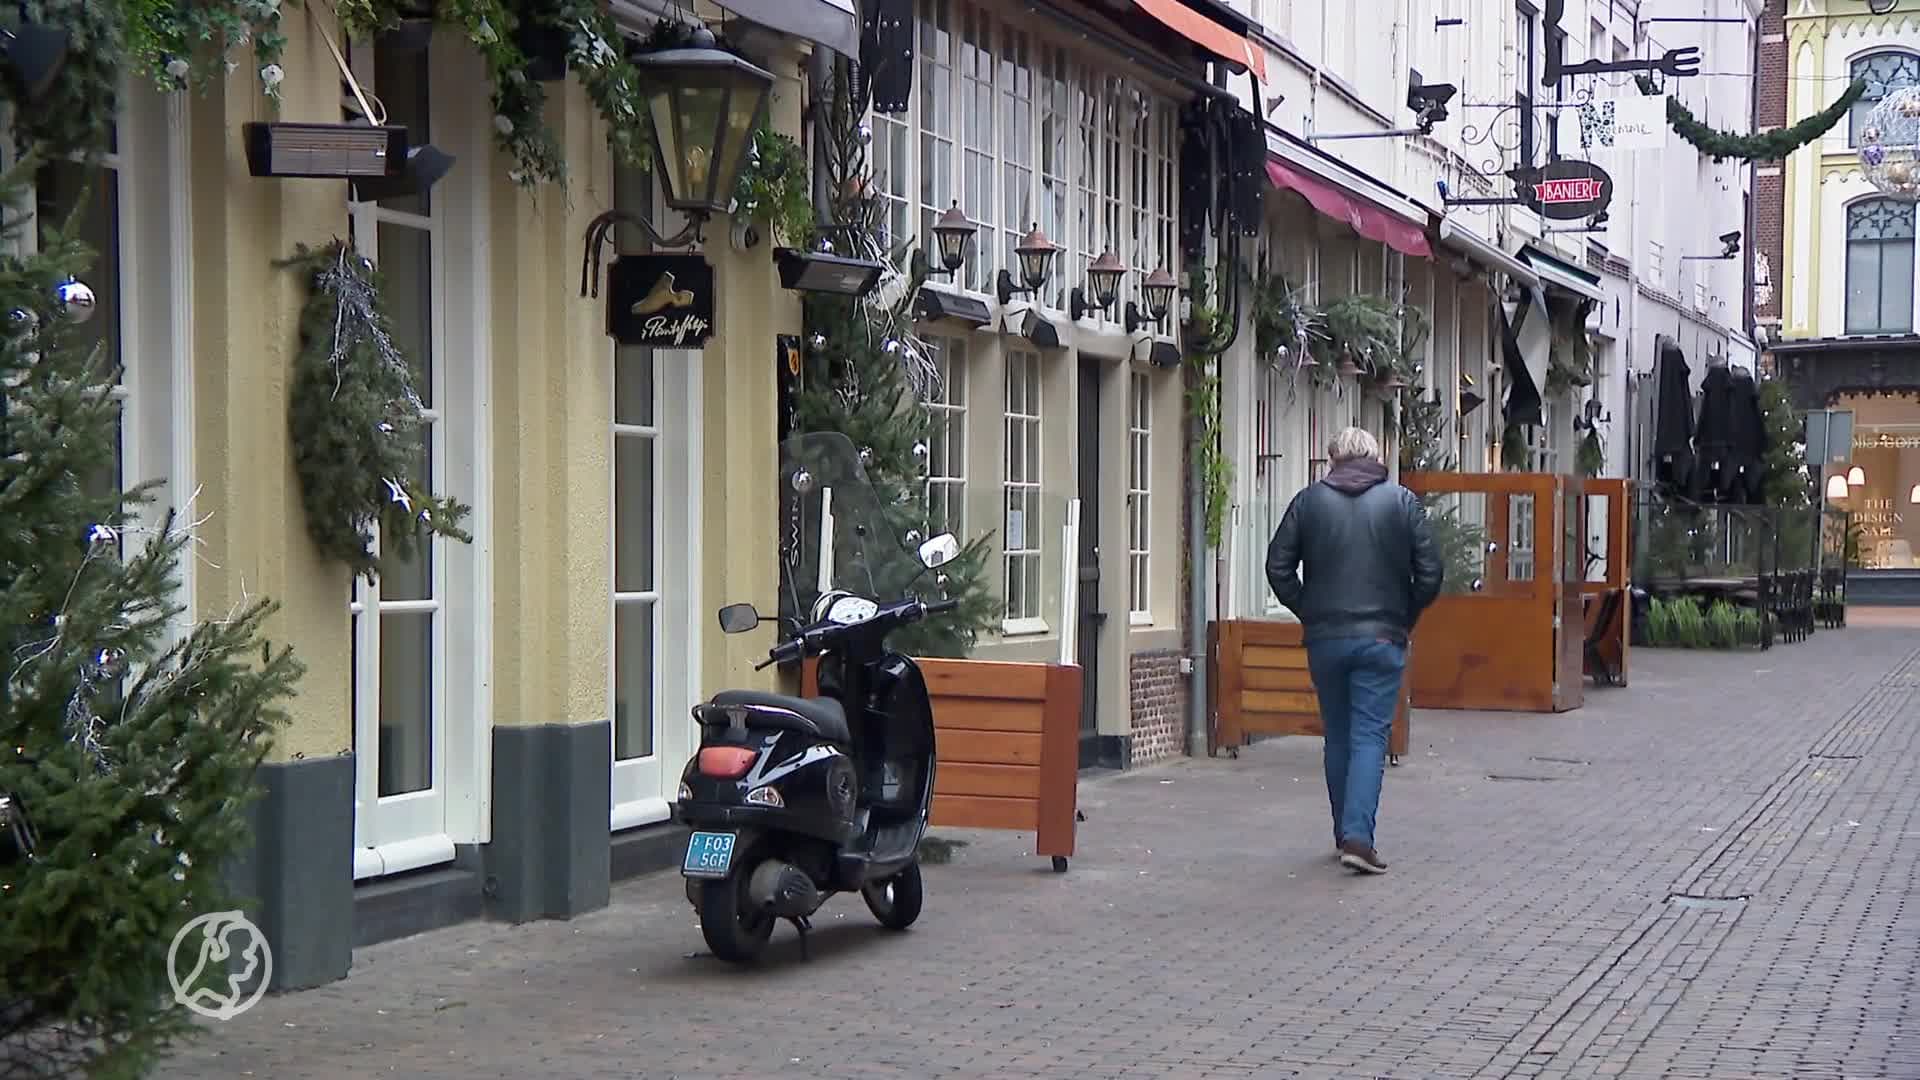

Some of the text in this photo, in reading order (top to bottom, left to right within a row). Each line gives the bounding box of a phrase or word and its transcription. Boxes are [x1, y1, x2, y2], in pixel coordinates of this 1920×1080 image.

[1546, 182, 1589, 200] BANIER
[1864, 499, 1893, 509] THE
[1854, 512, 1903, 523] DESIGN
[1860, 526, 1894, 537] SALE
